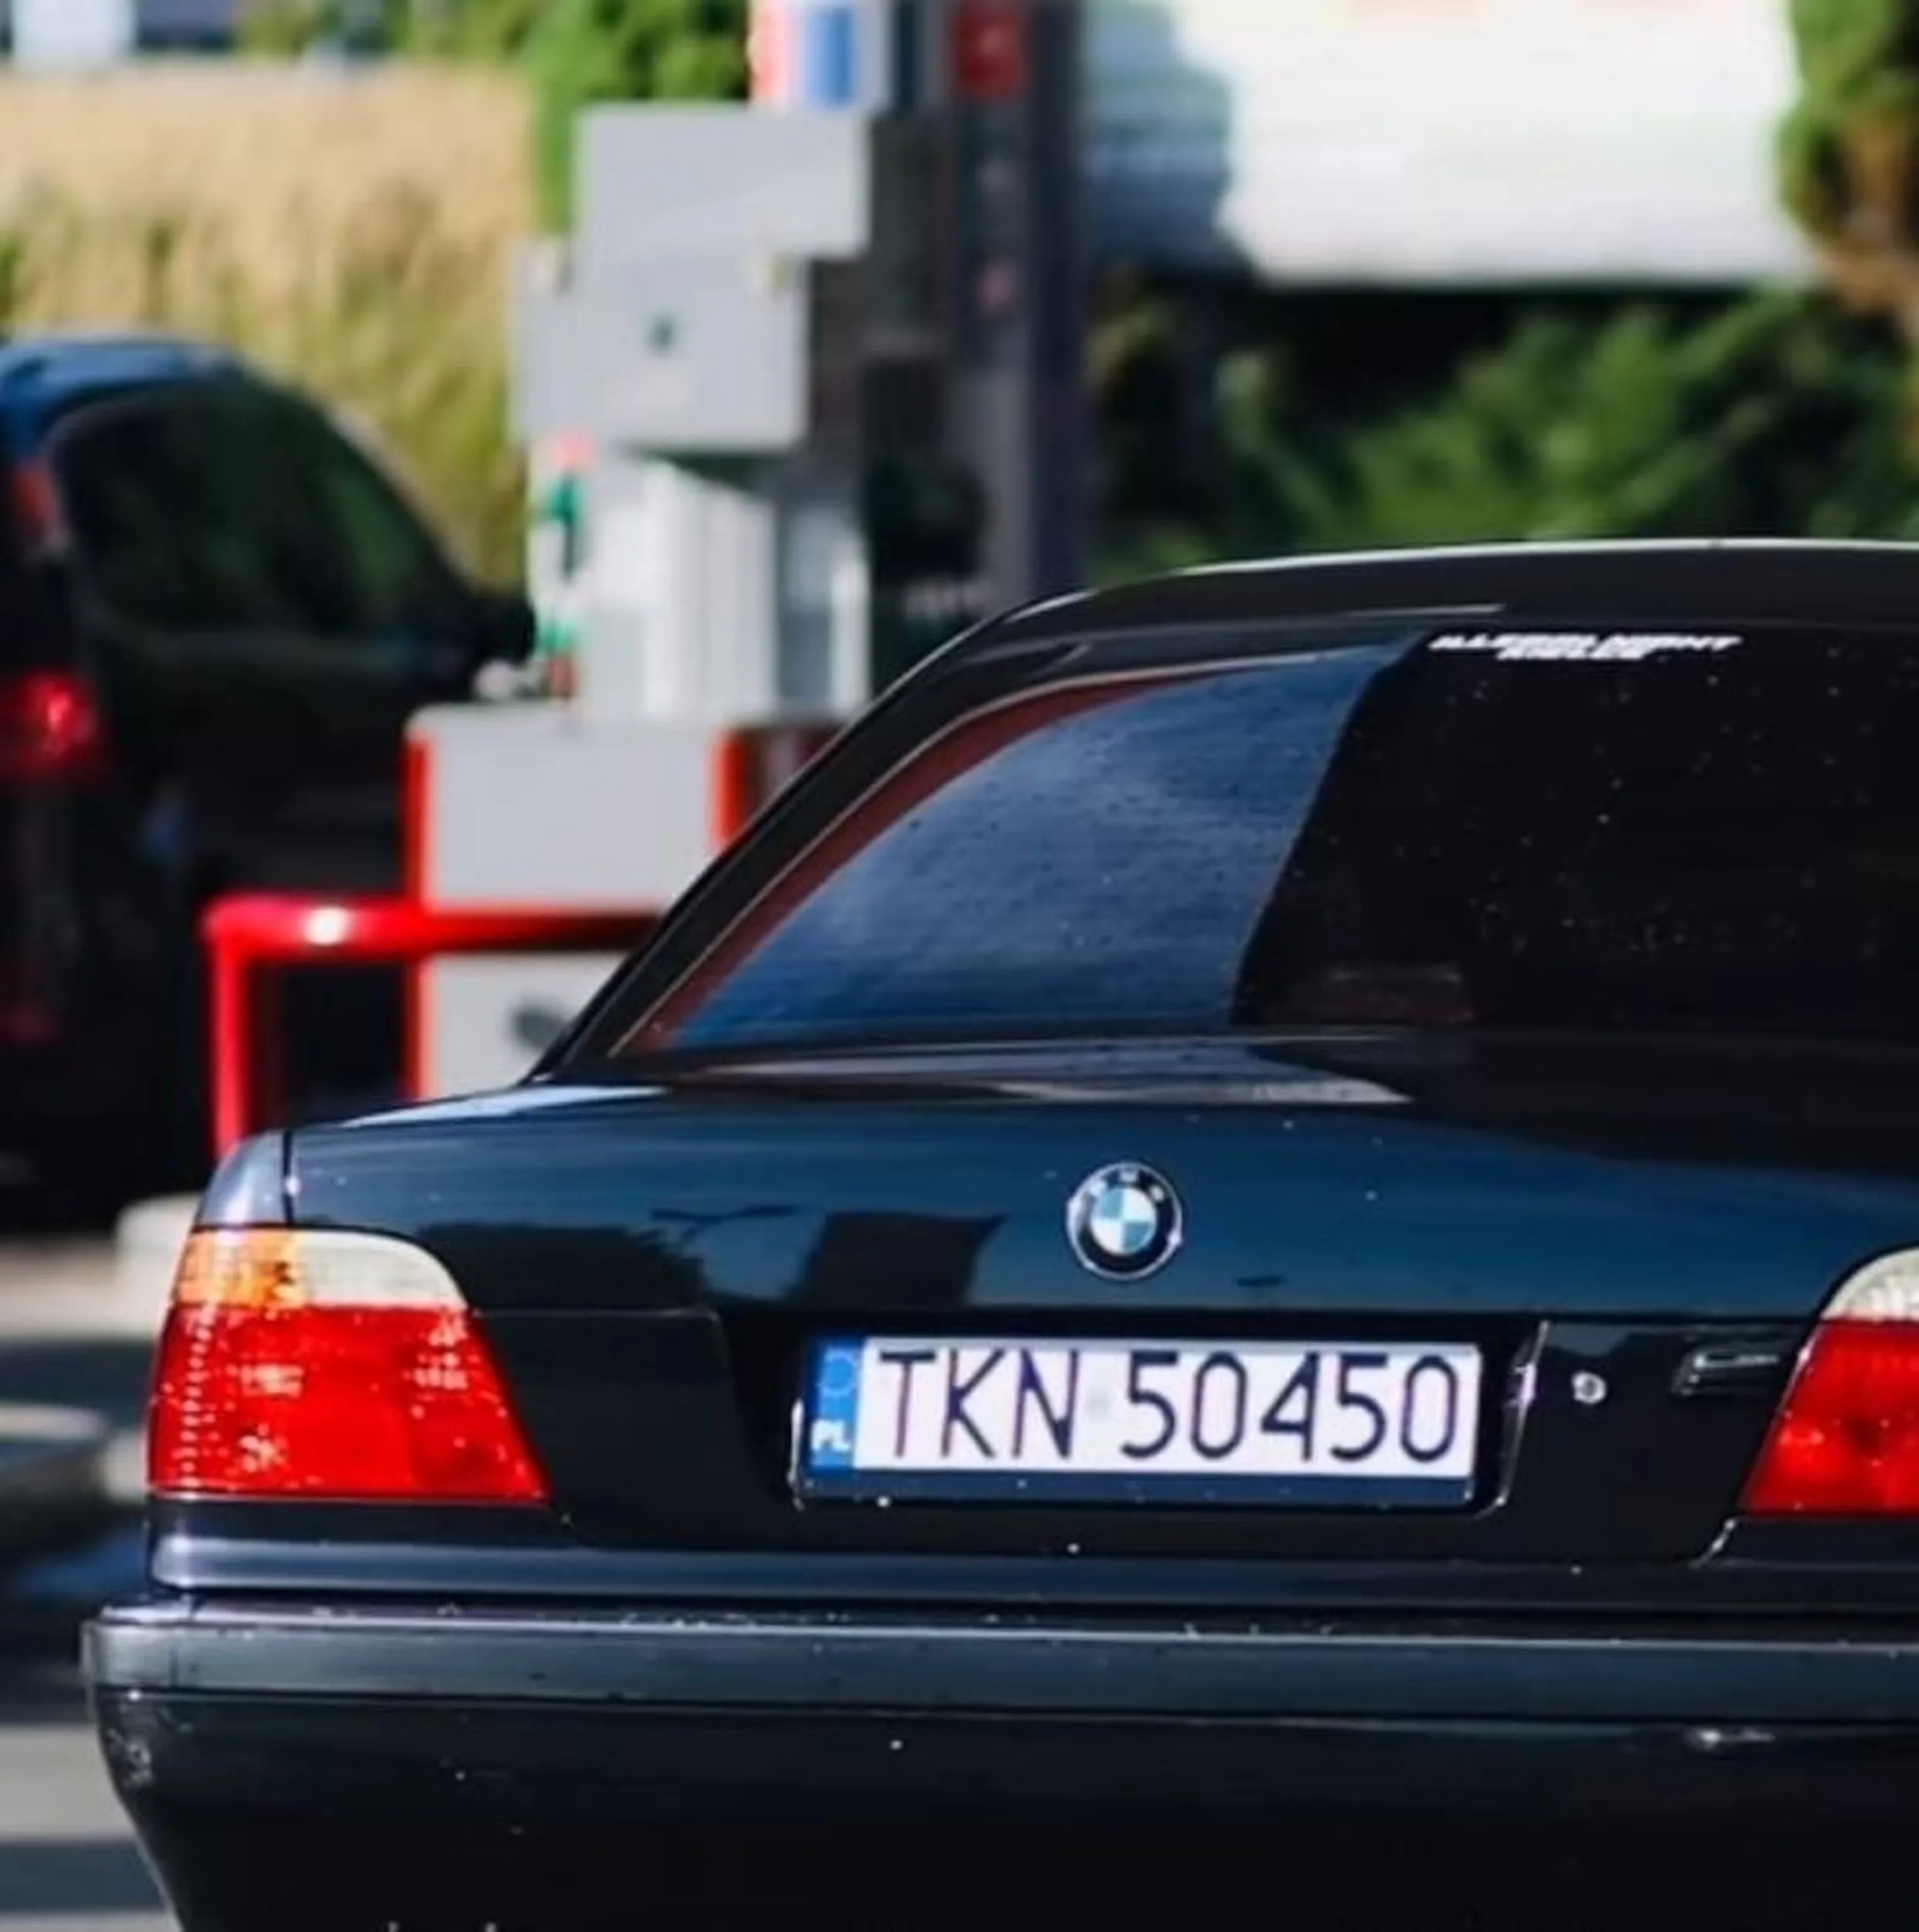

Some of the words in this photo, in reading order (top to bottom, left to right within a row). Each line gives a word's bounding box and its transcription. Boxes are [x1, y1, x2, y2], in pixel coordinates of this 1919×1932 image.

[811, 1419, 852, 1451] PL
[880, 1350, 1079, 1459] TKN
[1120, 1352, 1458, 1463] 50450
